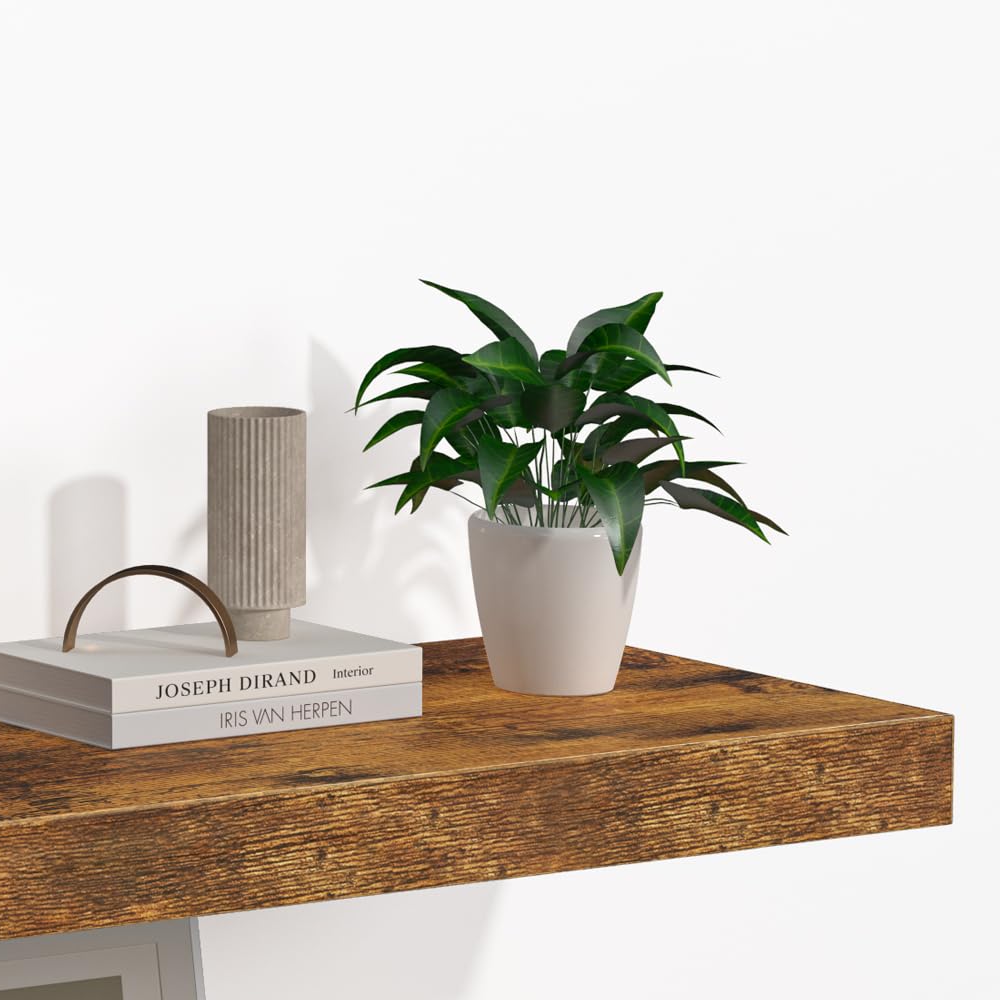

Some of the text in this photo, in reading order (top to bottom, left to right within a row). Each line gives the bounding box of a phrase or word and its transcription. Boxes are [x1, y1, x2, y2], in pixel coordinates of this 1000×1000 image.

[155, 666, 374, 700] JOSEPH DIRAND Interior
[220, 699, 352, 728] IRIS VAN HERPEN
